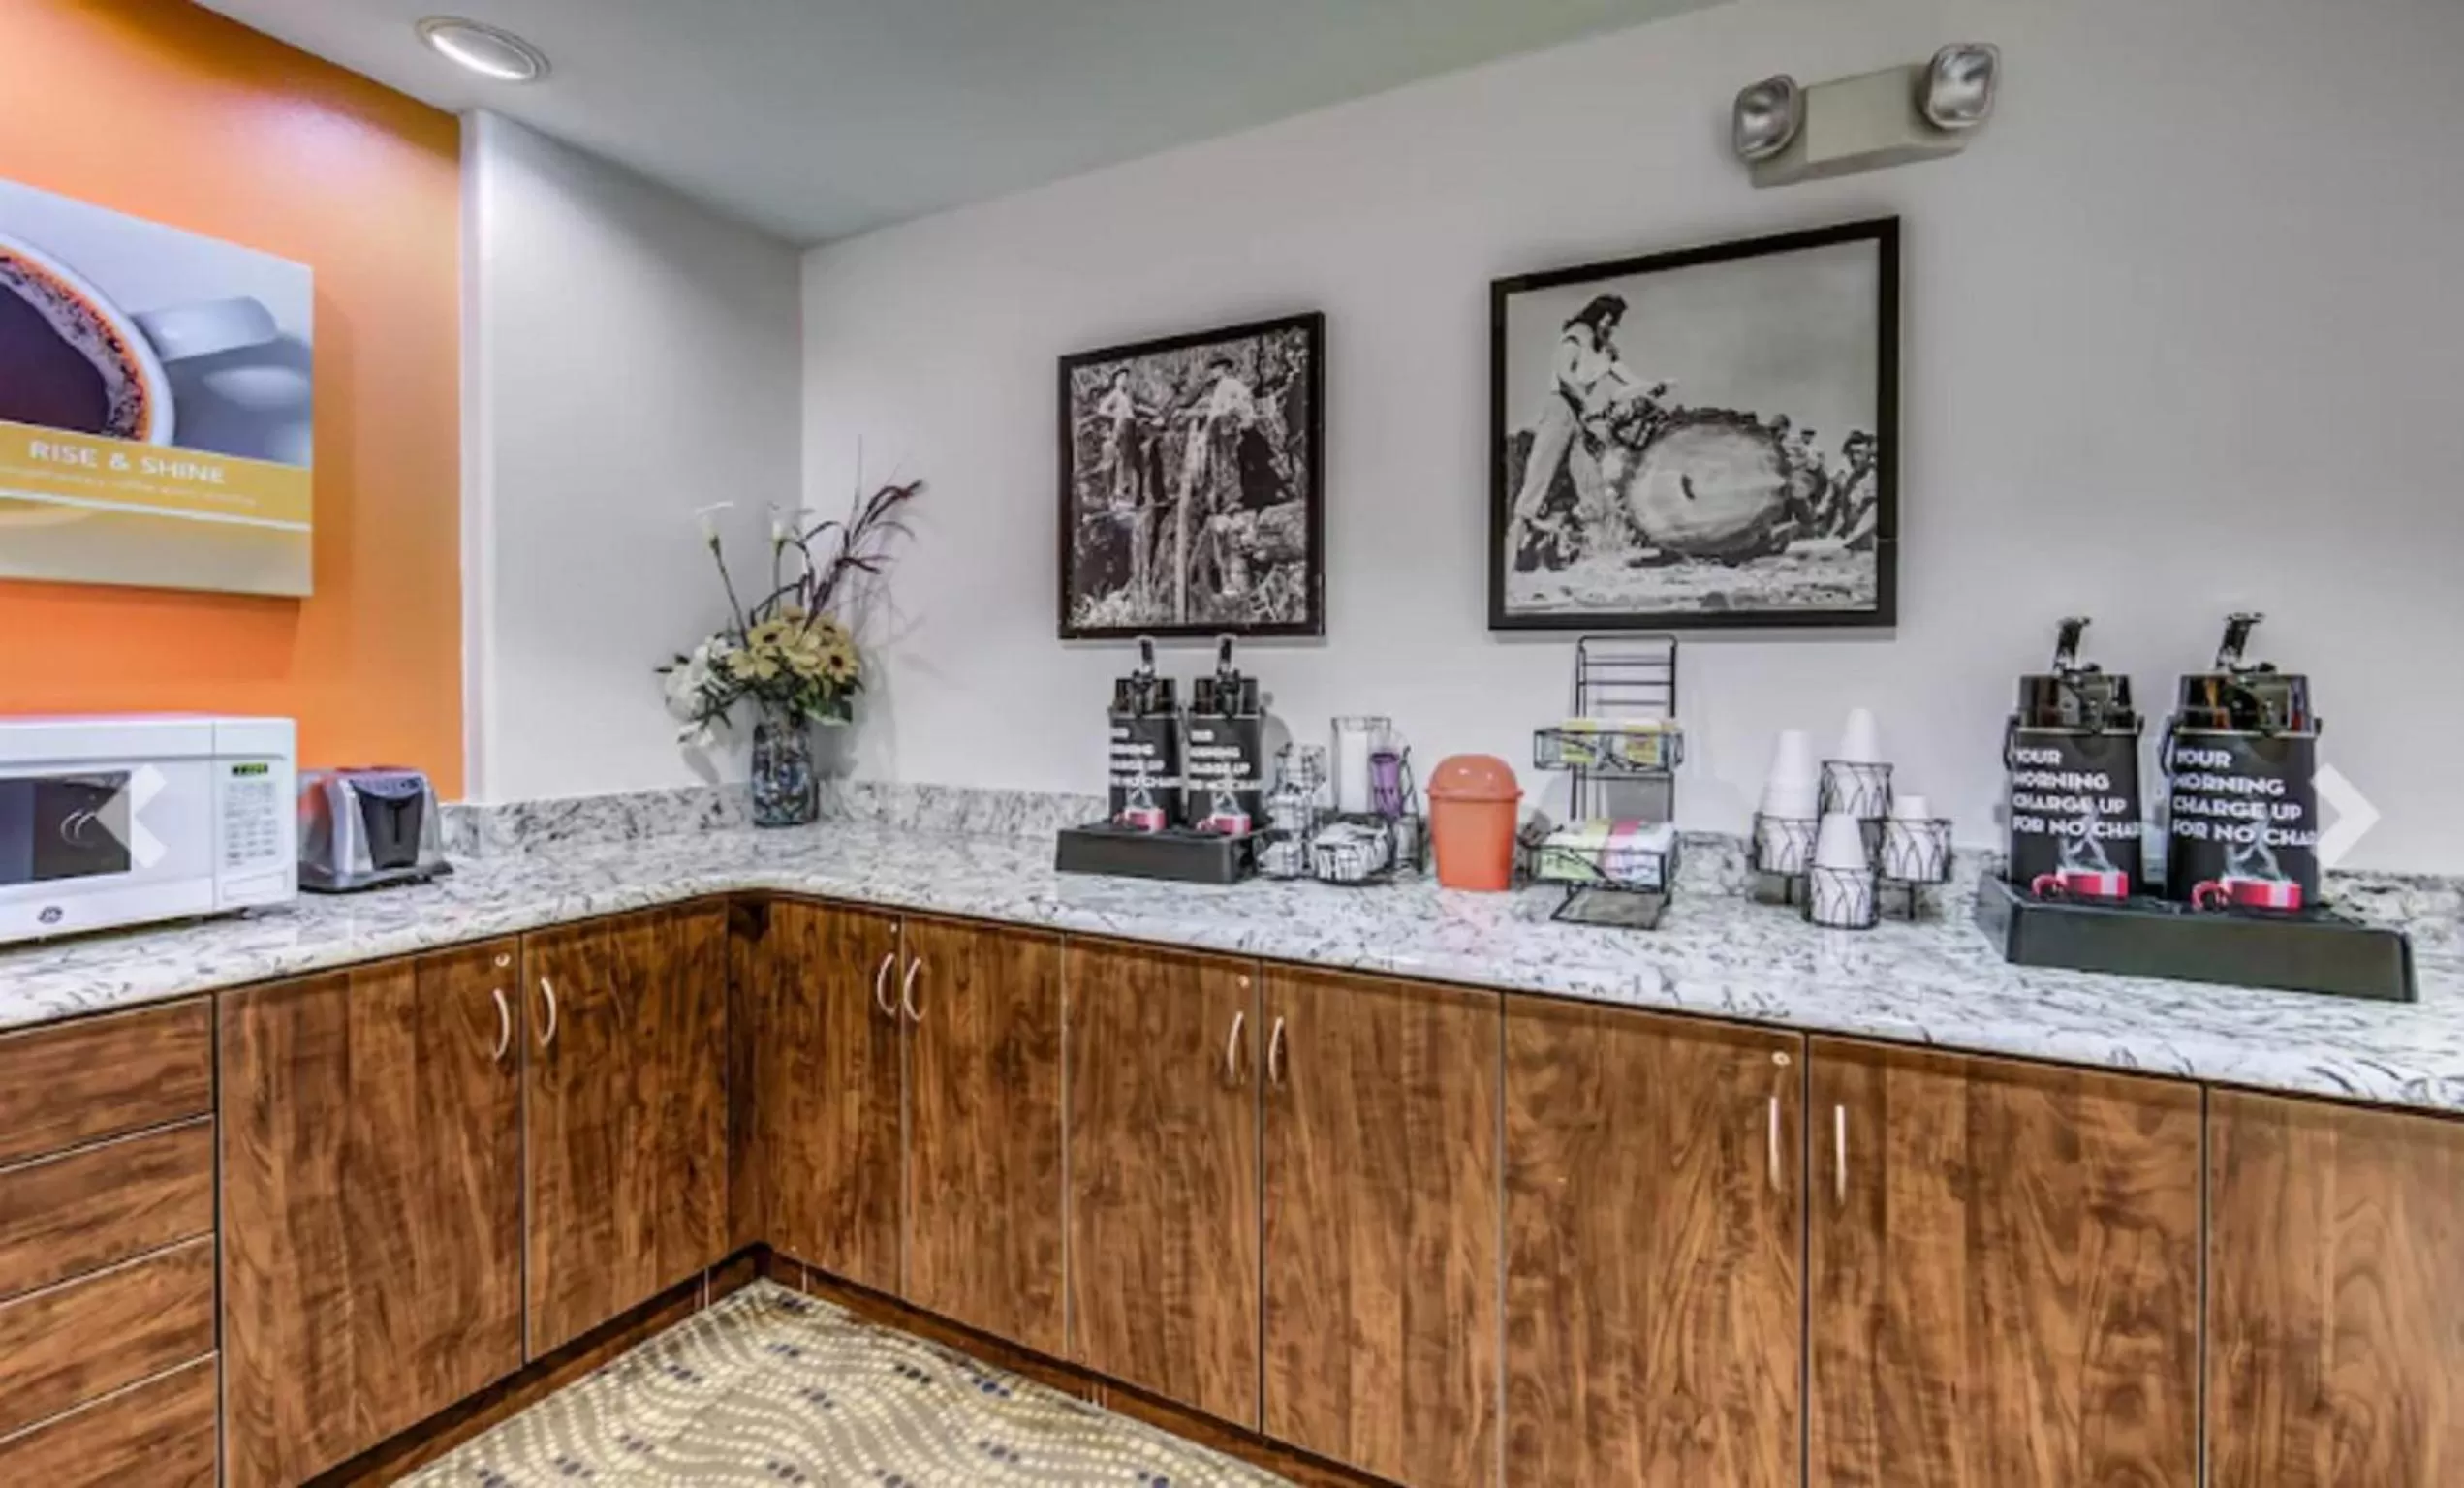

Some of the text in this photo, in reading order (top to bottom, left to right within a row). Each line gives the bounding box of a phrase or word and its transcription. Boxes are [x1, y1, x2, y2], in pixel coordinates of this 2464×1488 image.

[30, 441, 226, 483] RISE & SHINE
[2098, 797, 2127, 814] UP
[2172, 796, 2303, 821] CHARGE UP
[2048, 818, 2085, 836] NO
[2213, 824, 2256, 843] NO
